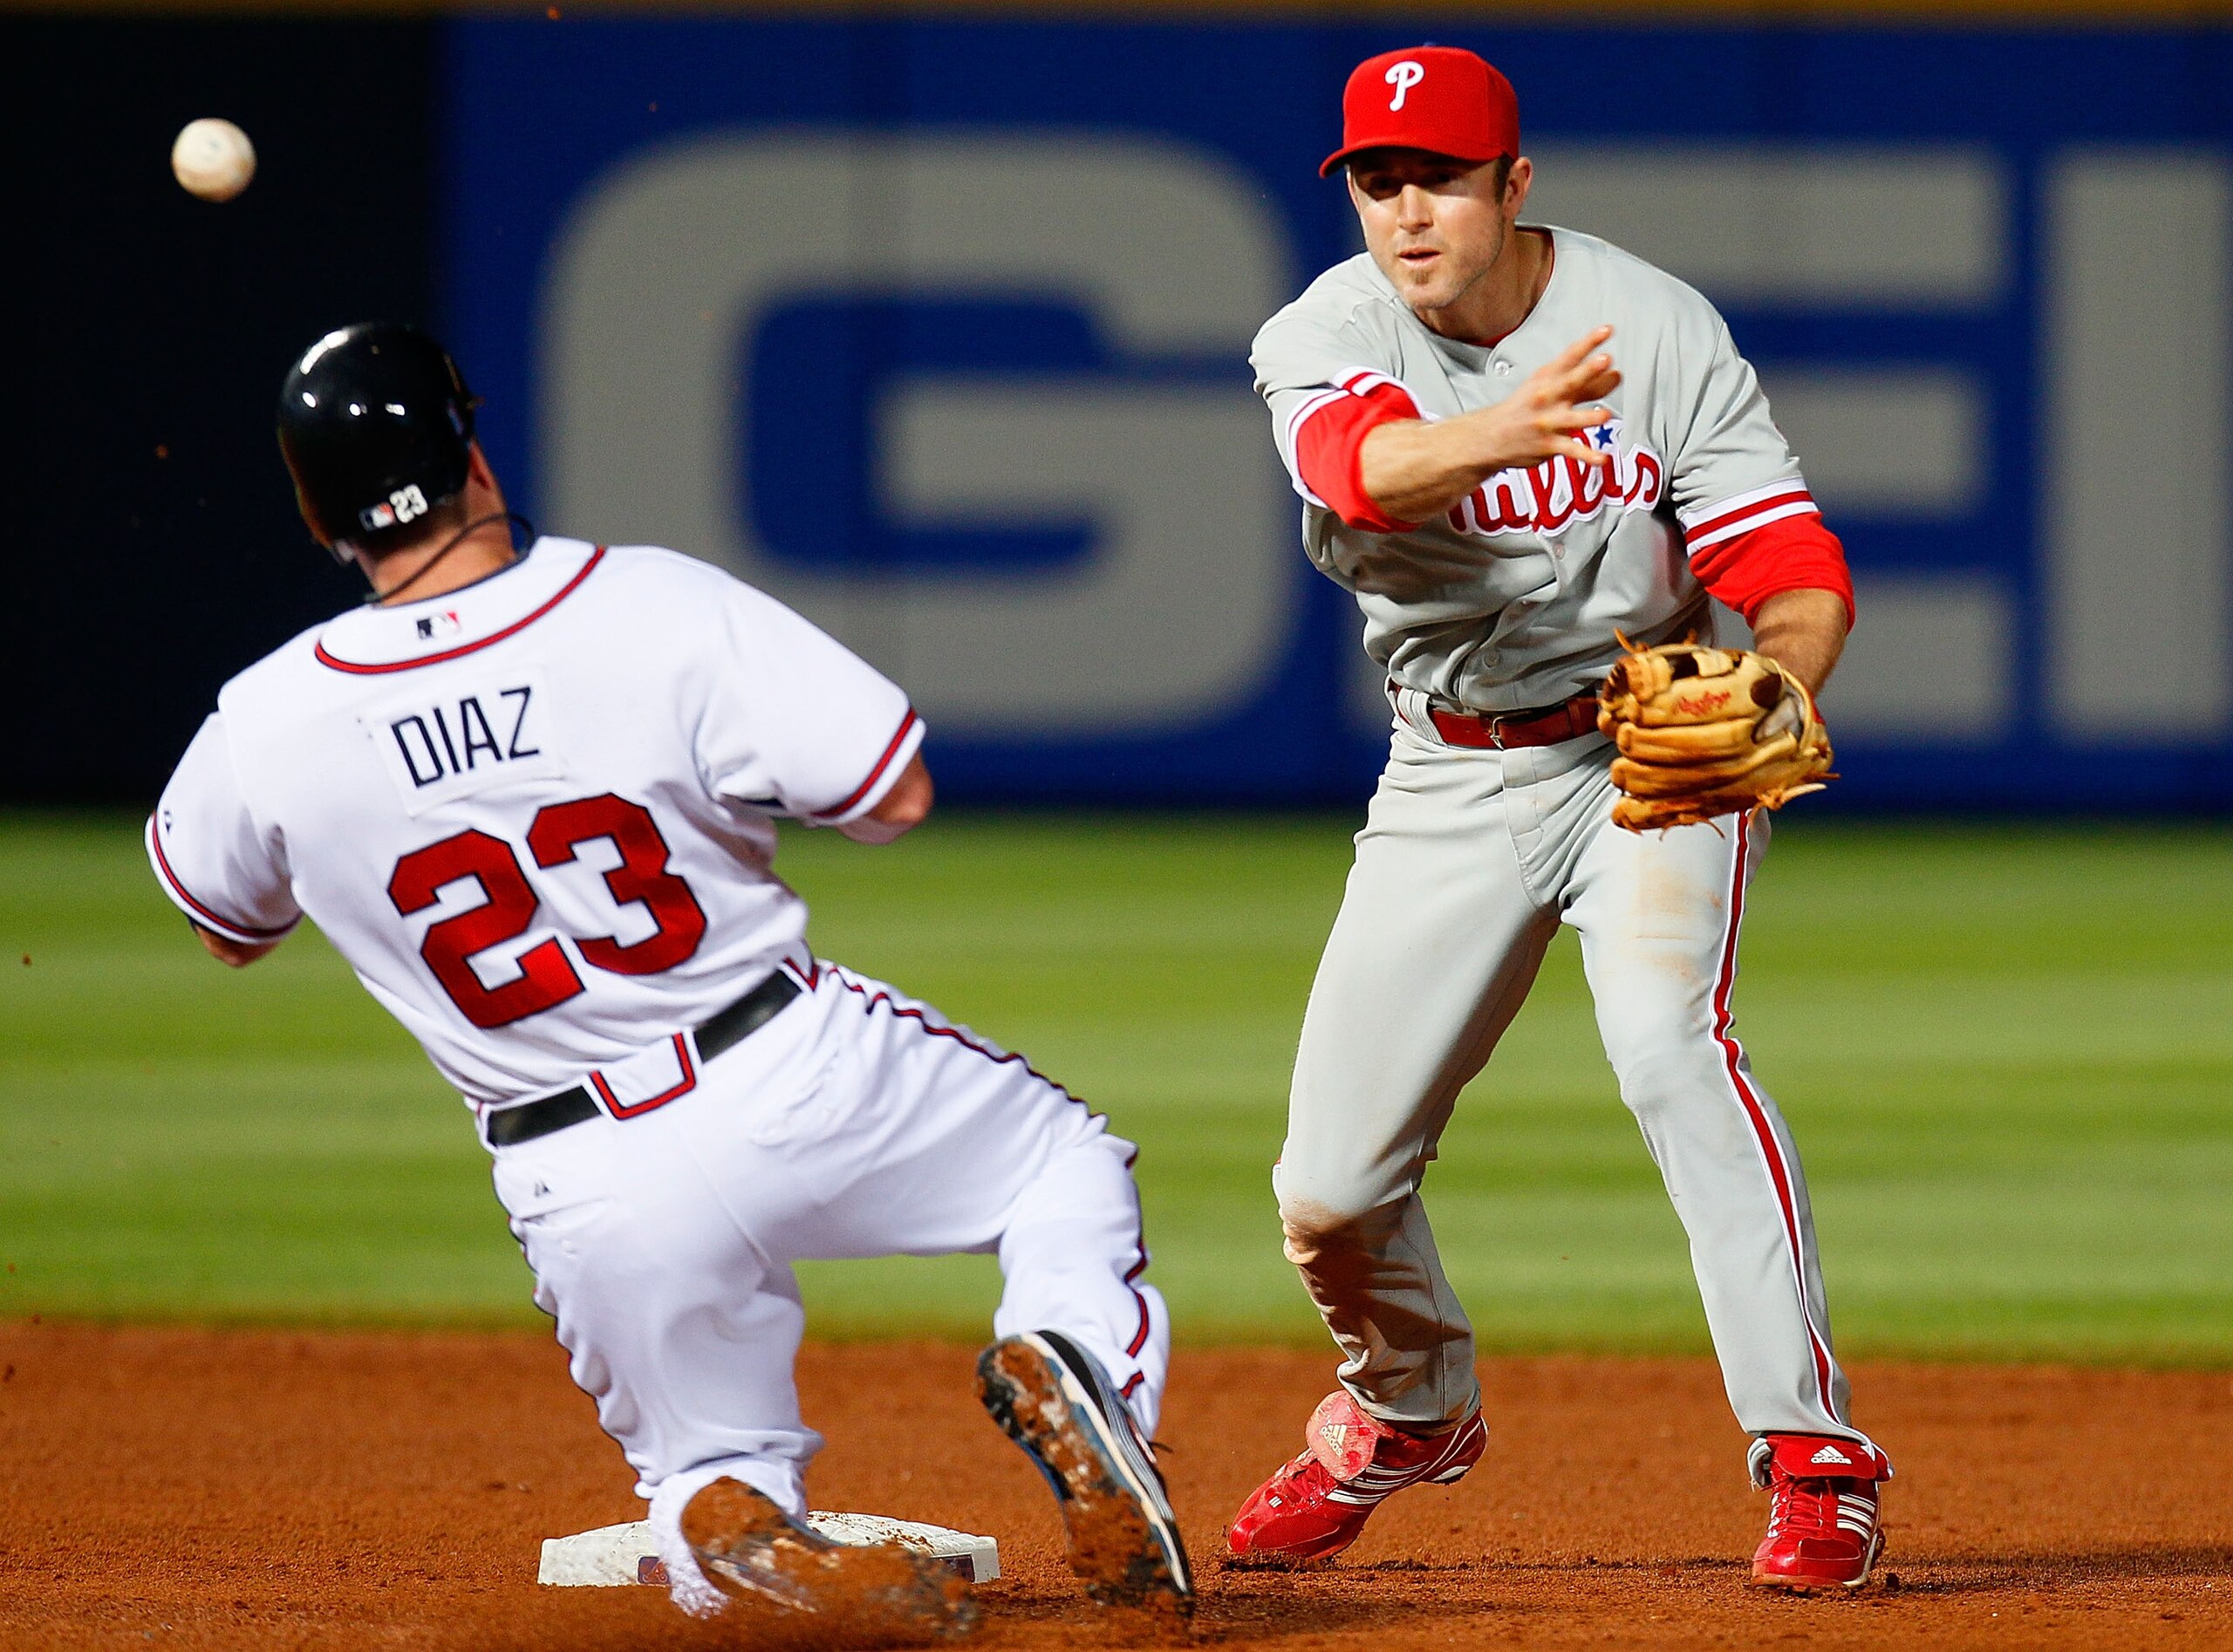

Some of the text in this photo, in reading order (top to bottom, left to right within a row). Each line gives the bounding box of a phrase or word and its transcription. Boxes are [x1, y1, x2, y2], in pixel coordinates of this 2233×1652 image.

[1384, 60, 1425, 113] P
[389, 484, 428, 523] 23
[391, 686, 539, 788] DIAZ
[386, 793, 708, 1029] 23
[1320, 1425, 1344, 1457] adidas
